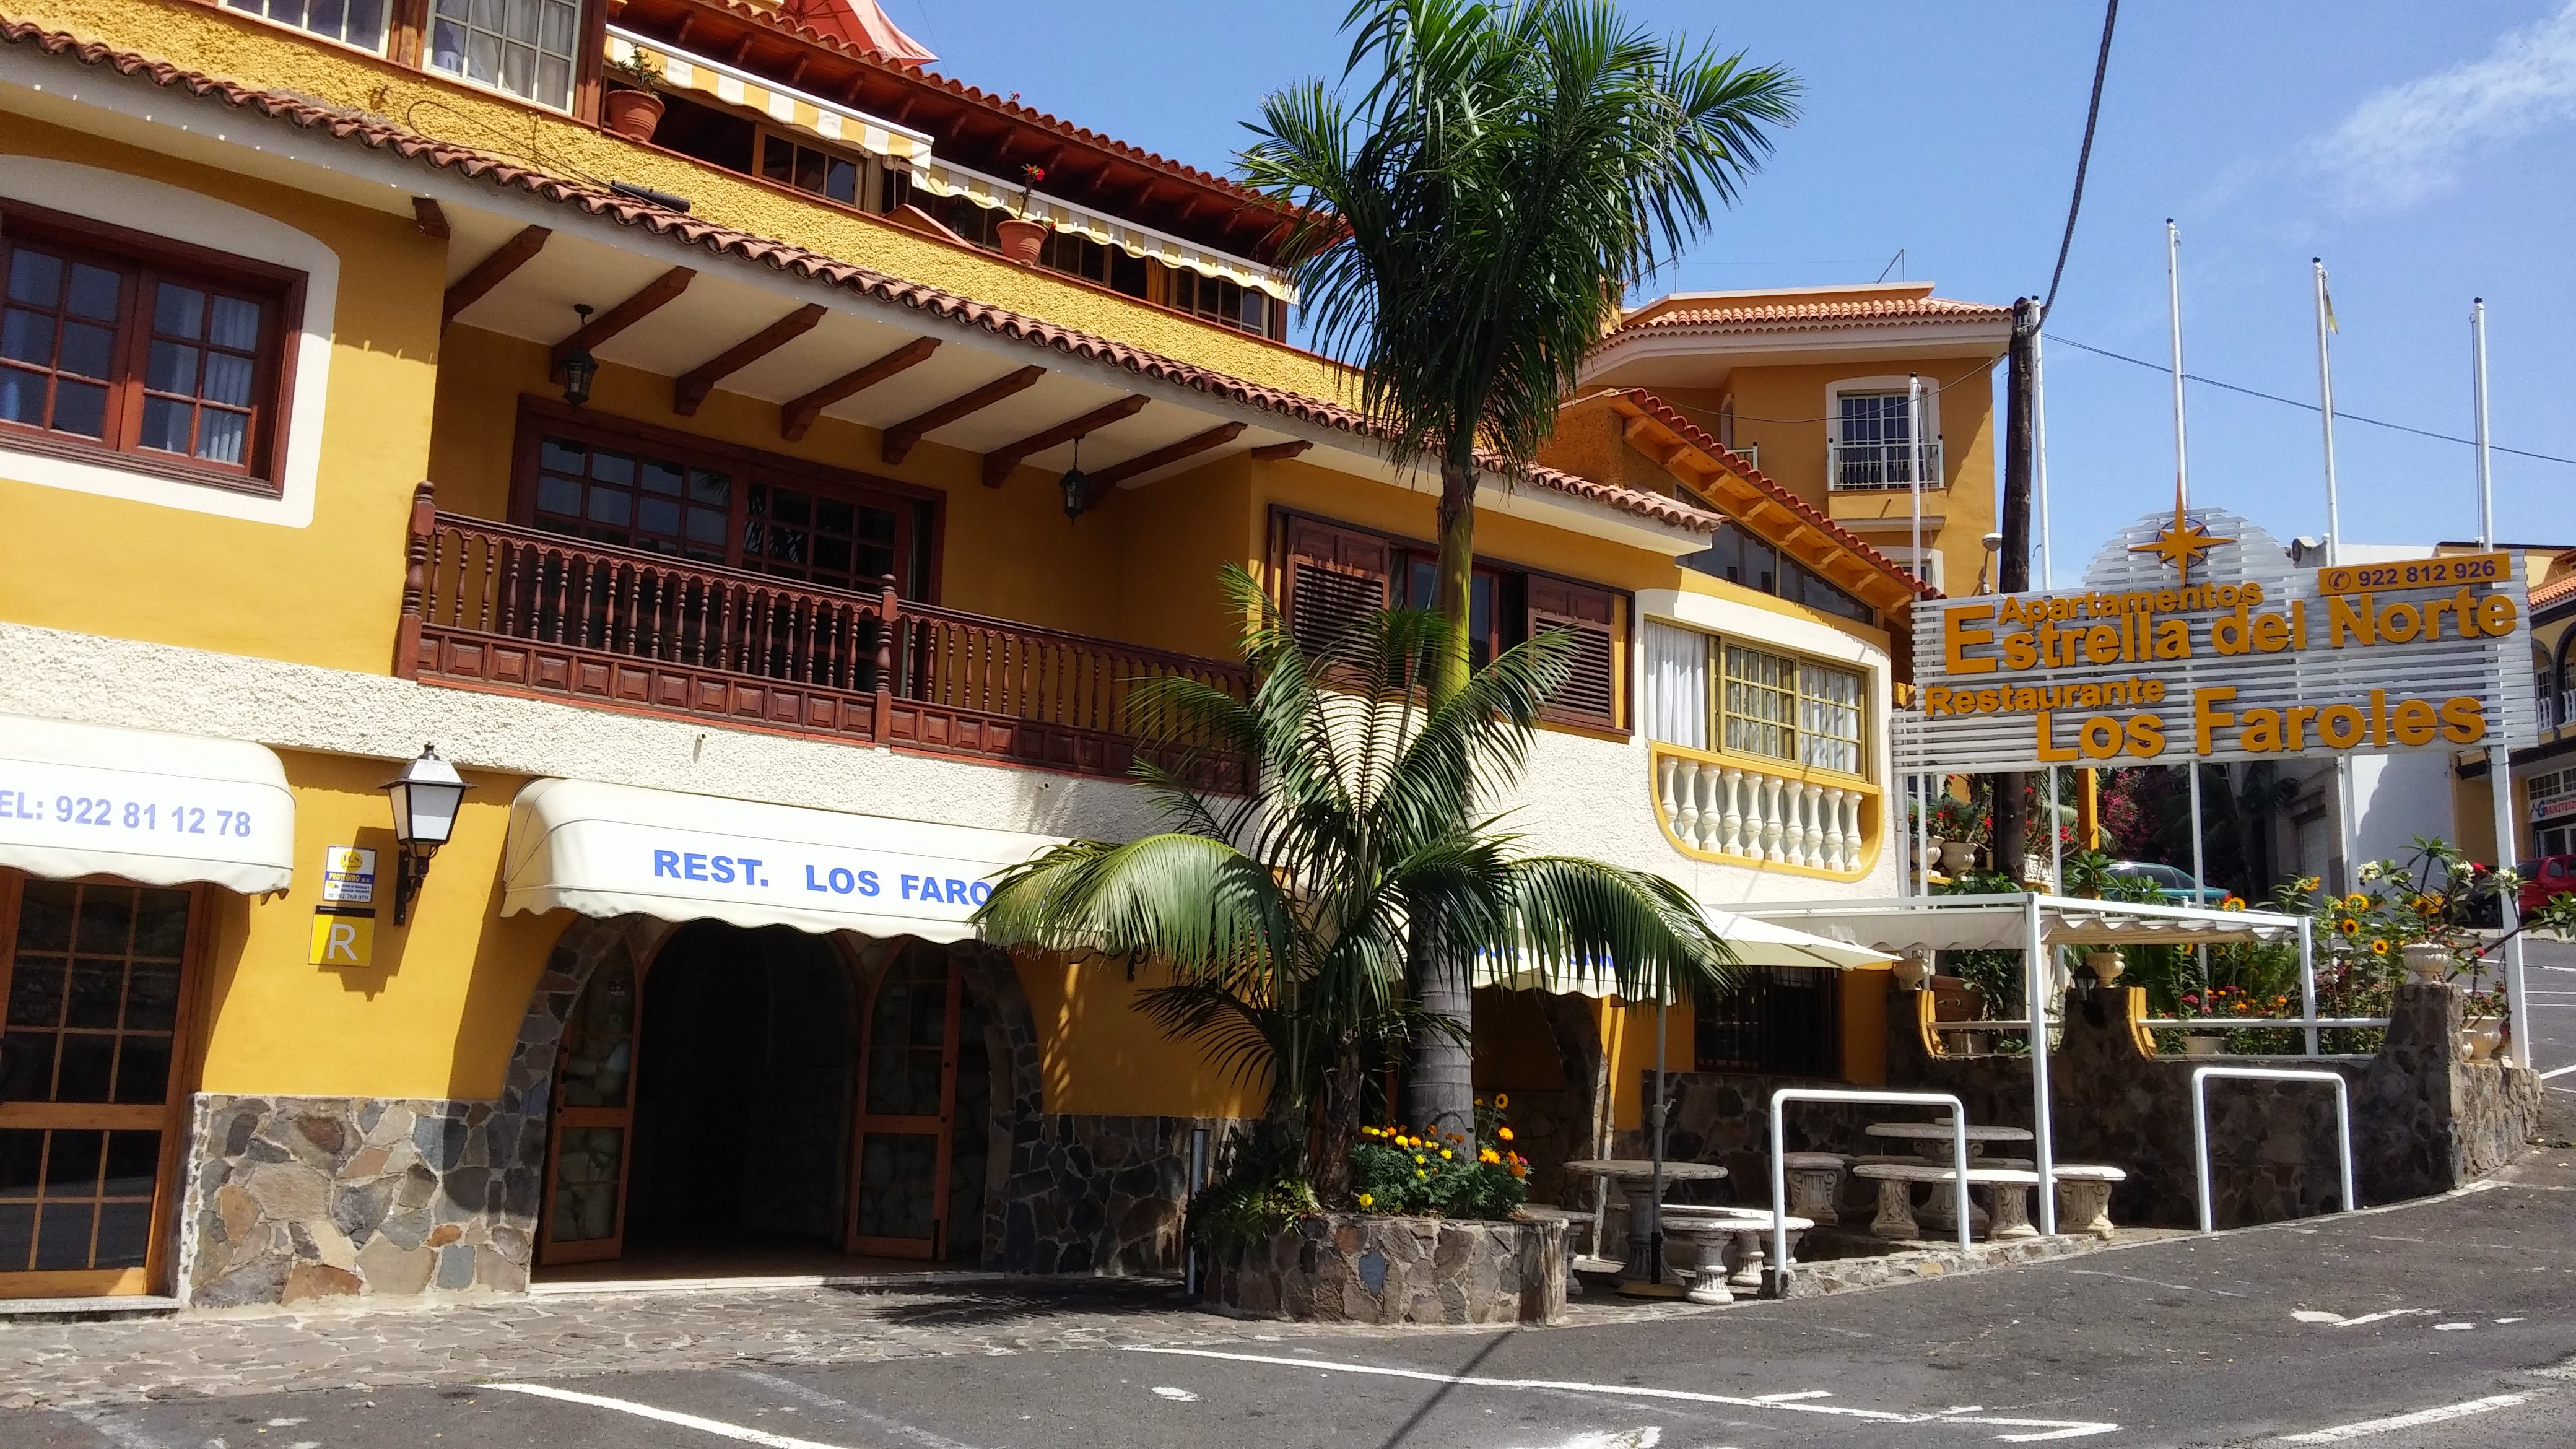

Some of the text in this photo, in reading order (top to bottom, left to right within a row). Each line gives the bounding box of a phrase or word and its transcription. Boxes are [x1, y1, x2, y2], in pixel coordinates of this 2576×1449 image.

[2358, 560, 2496, 587] 922 812 926
[1998, 581, 2265, 630] Apartamentos
[1944, 586, 2518, 676] Estrella del Norte
[1925, 676, 2166, 716] Restaurante
[2036, 686, 2487, 762] Los Faroles
[56, 794, 112, 827] 922
[123, 801, 157, 830] 81
[172, 805, 206, 835] 12
[216, 809, 251, 838] 78
[328, 872, 360, 882] PROTEGIDO
[653, 849, 769, 887] REST.
[806, 864, 881, 897] LOS
[328, 923, 359, 960] R
